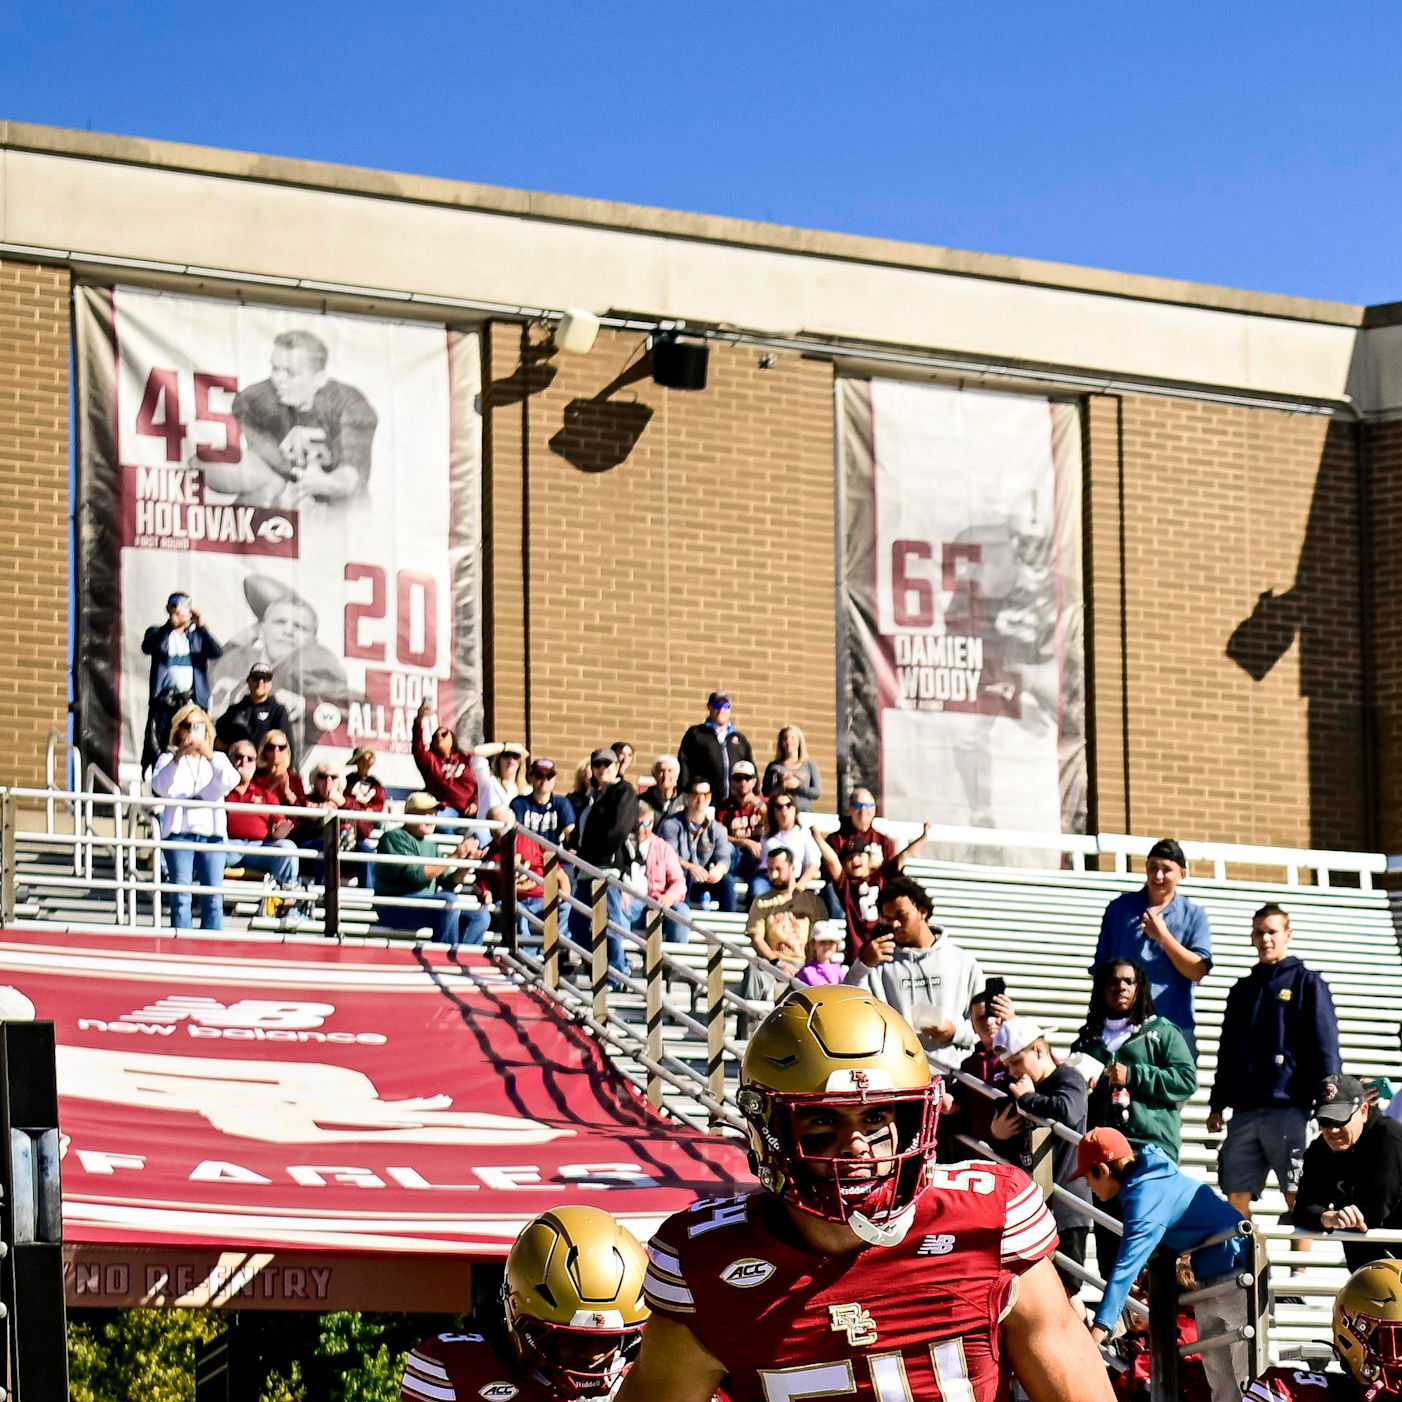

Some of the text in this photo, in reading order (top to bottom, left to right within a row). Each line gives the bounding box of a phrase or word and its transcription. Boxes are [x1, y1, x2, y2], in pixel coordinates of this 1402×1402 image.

[136, 366, 242, 464] 45
[136, 467, 201, 505] MIKE
[135, 500, 256, 544] HOLOVAK
[892, 540, 982, 632] 65
[344, 562, 438, 667] 20
[894, 635, 984, 669] DAMIEN
[390, 673, 438, 711] DON
[897, 667, 982, 702] WOODY
[77, 1017, 389, 1046] new balance
[75, 1261, 333, 1300] NO RE-ENTRY
[729, 1262, 767, 1280] ACC
[483, 1385, 514, 1396] ACC
